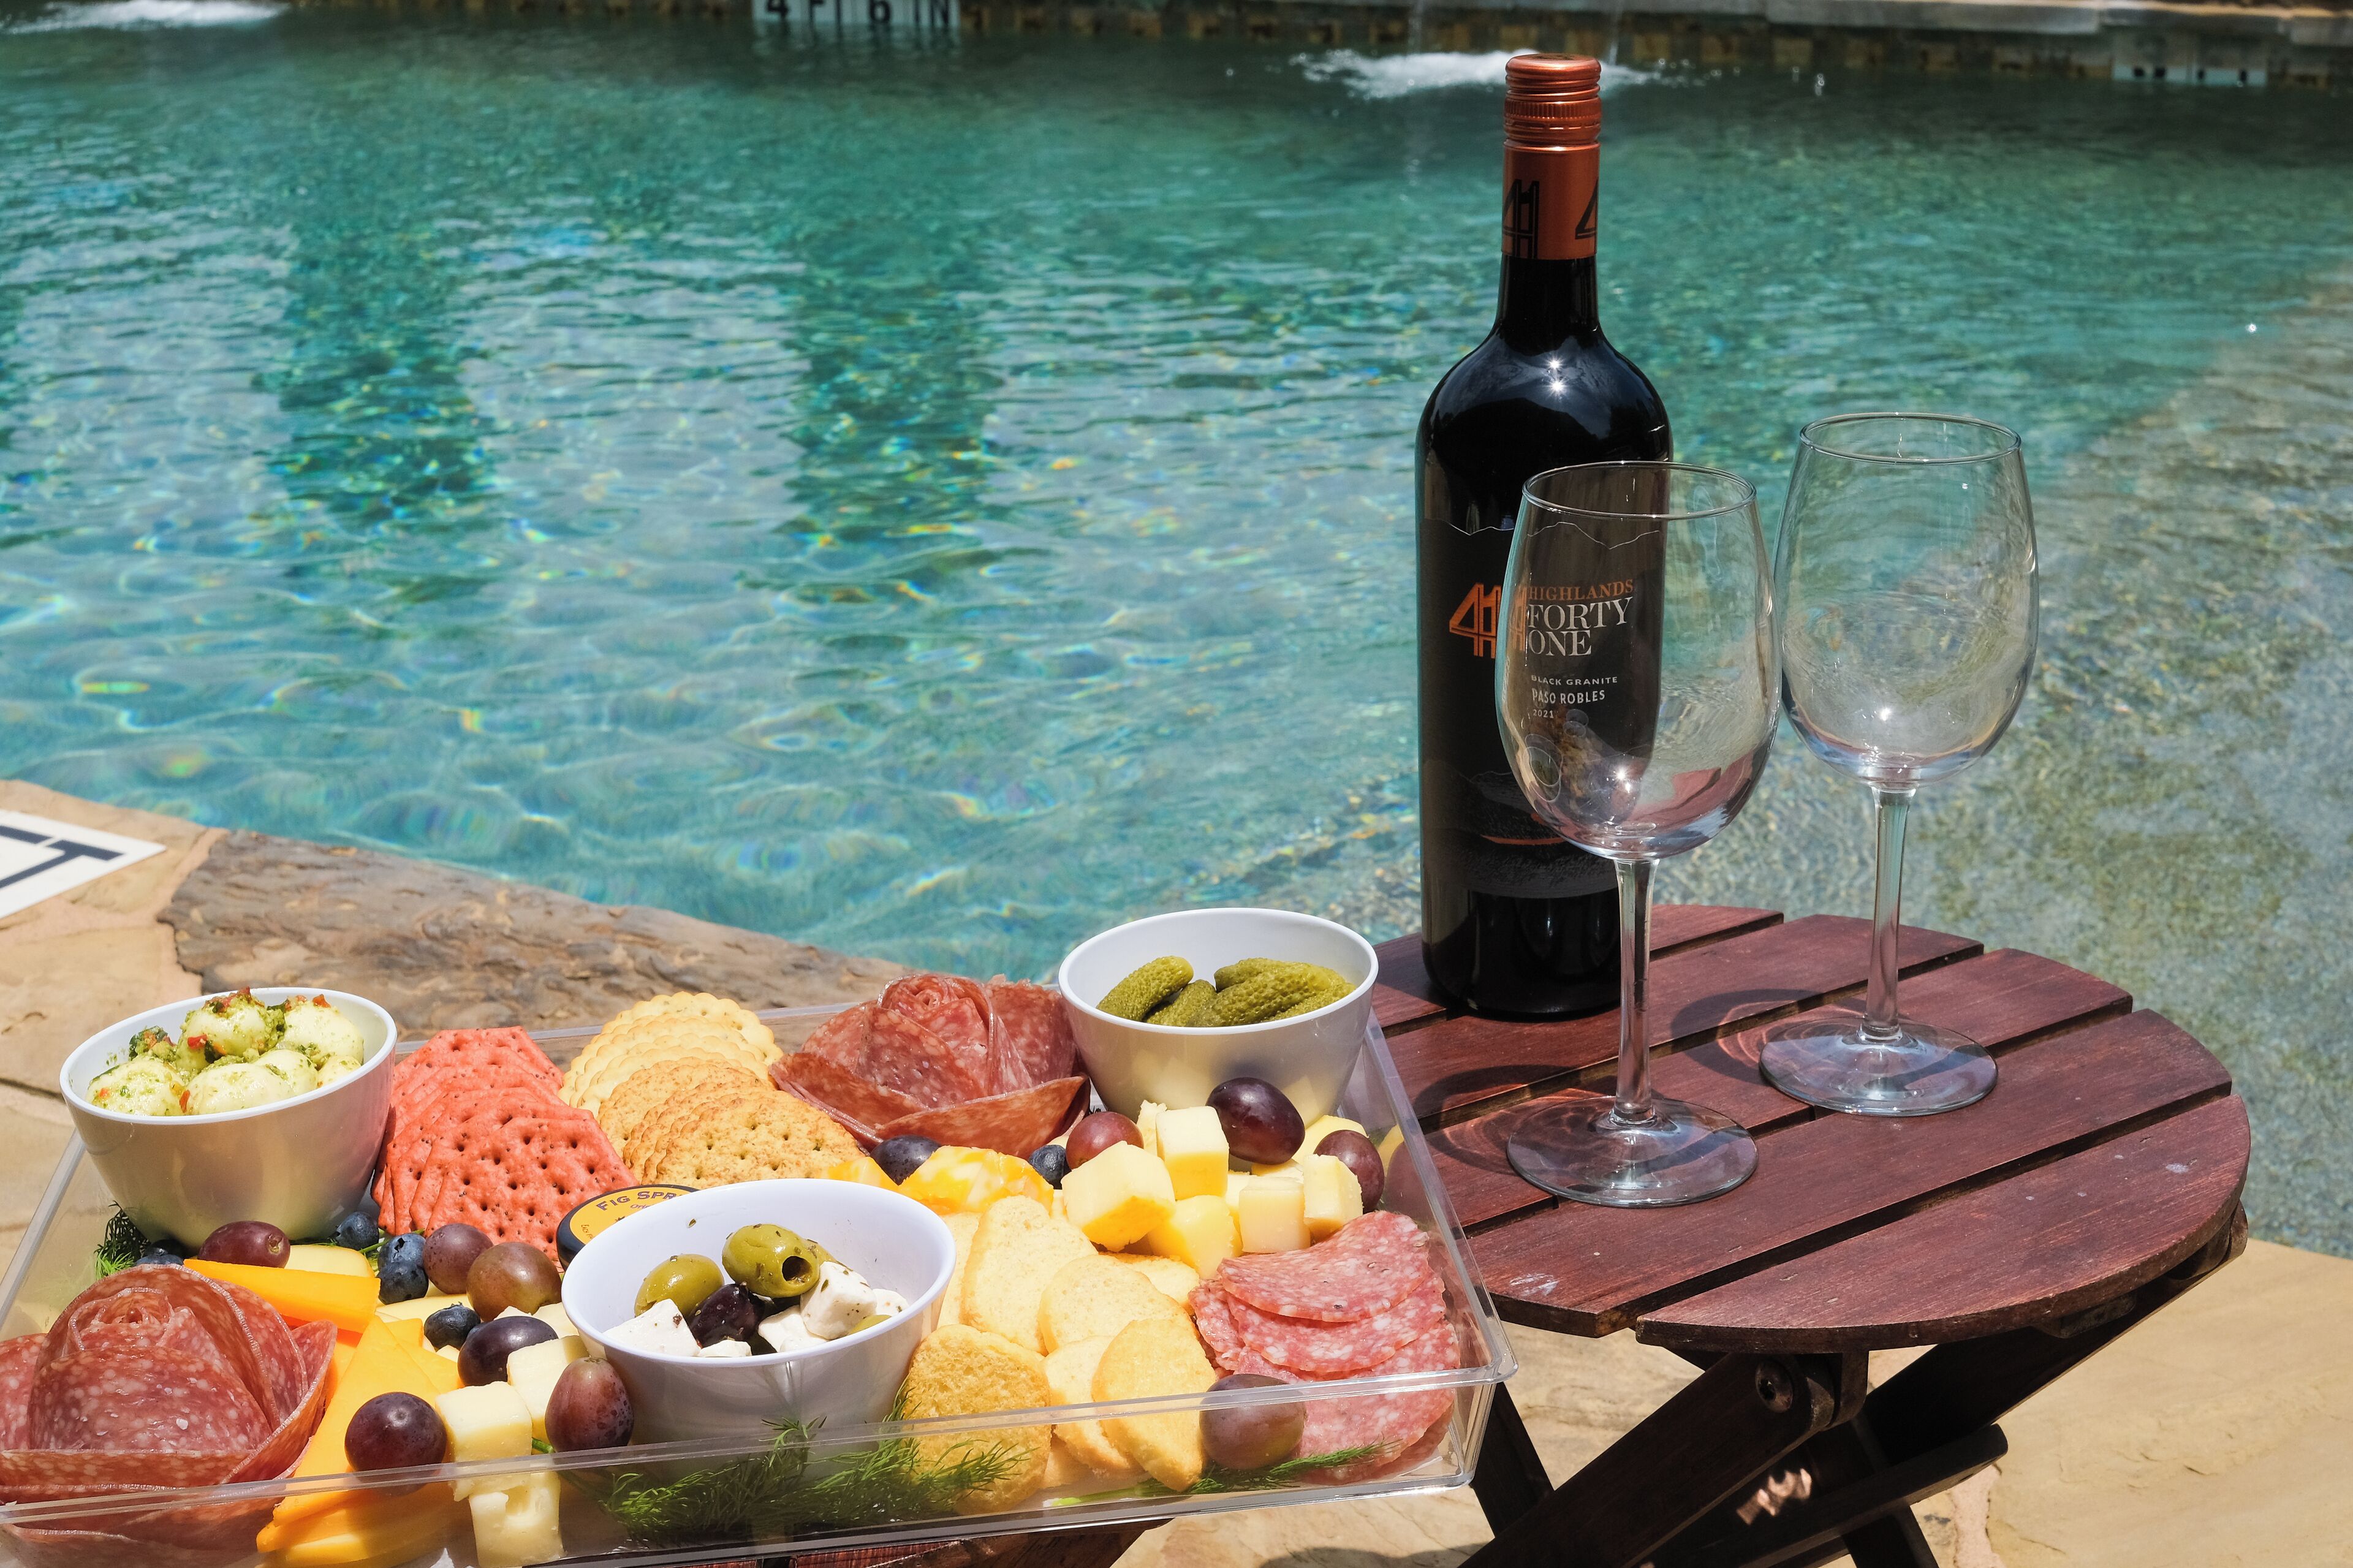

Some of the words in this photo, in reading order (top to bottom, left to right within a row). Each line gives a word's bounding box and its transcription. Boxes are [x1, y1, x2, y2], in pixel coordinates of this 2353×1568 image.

[1529, 579, 1633, 600] HIGHLANDS
[1528, 596, 1633, 630] FORTY
[1528, 629, 1591, 656] ONE
[1531, 675, 1561, 686] BLACK
[1566, 676, 1618, 686] GRANITE
[1532, 687, 1556, 704] PASO
[1560, 689, 1605, 704] ROBLES
[1533, 709, 1554, 718] 2021
[596, 1196, 630, 1211] FIG
[637, 1191, 684, 1200] SPR
